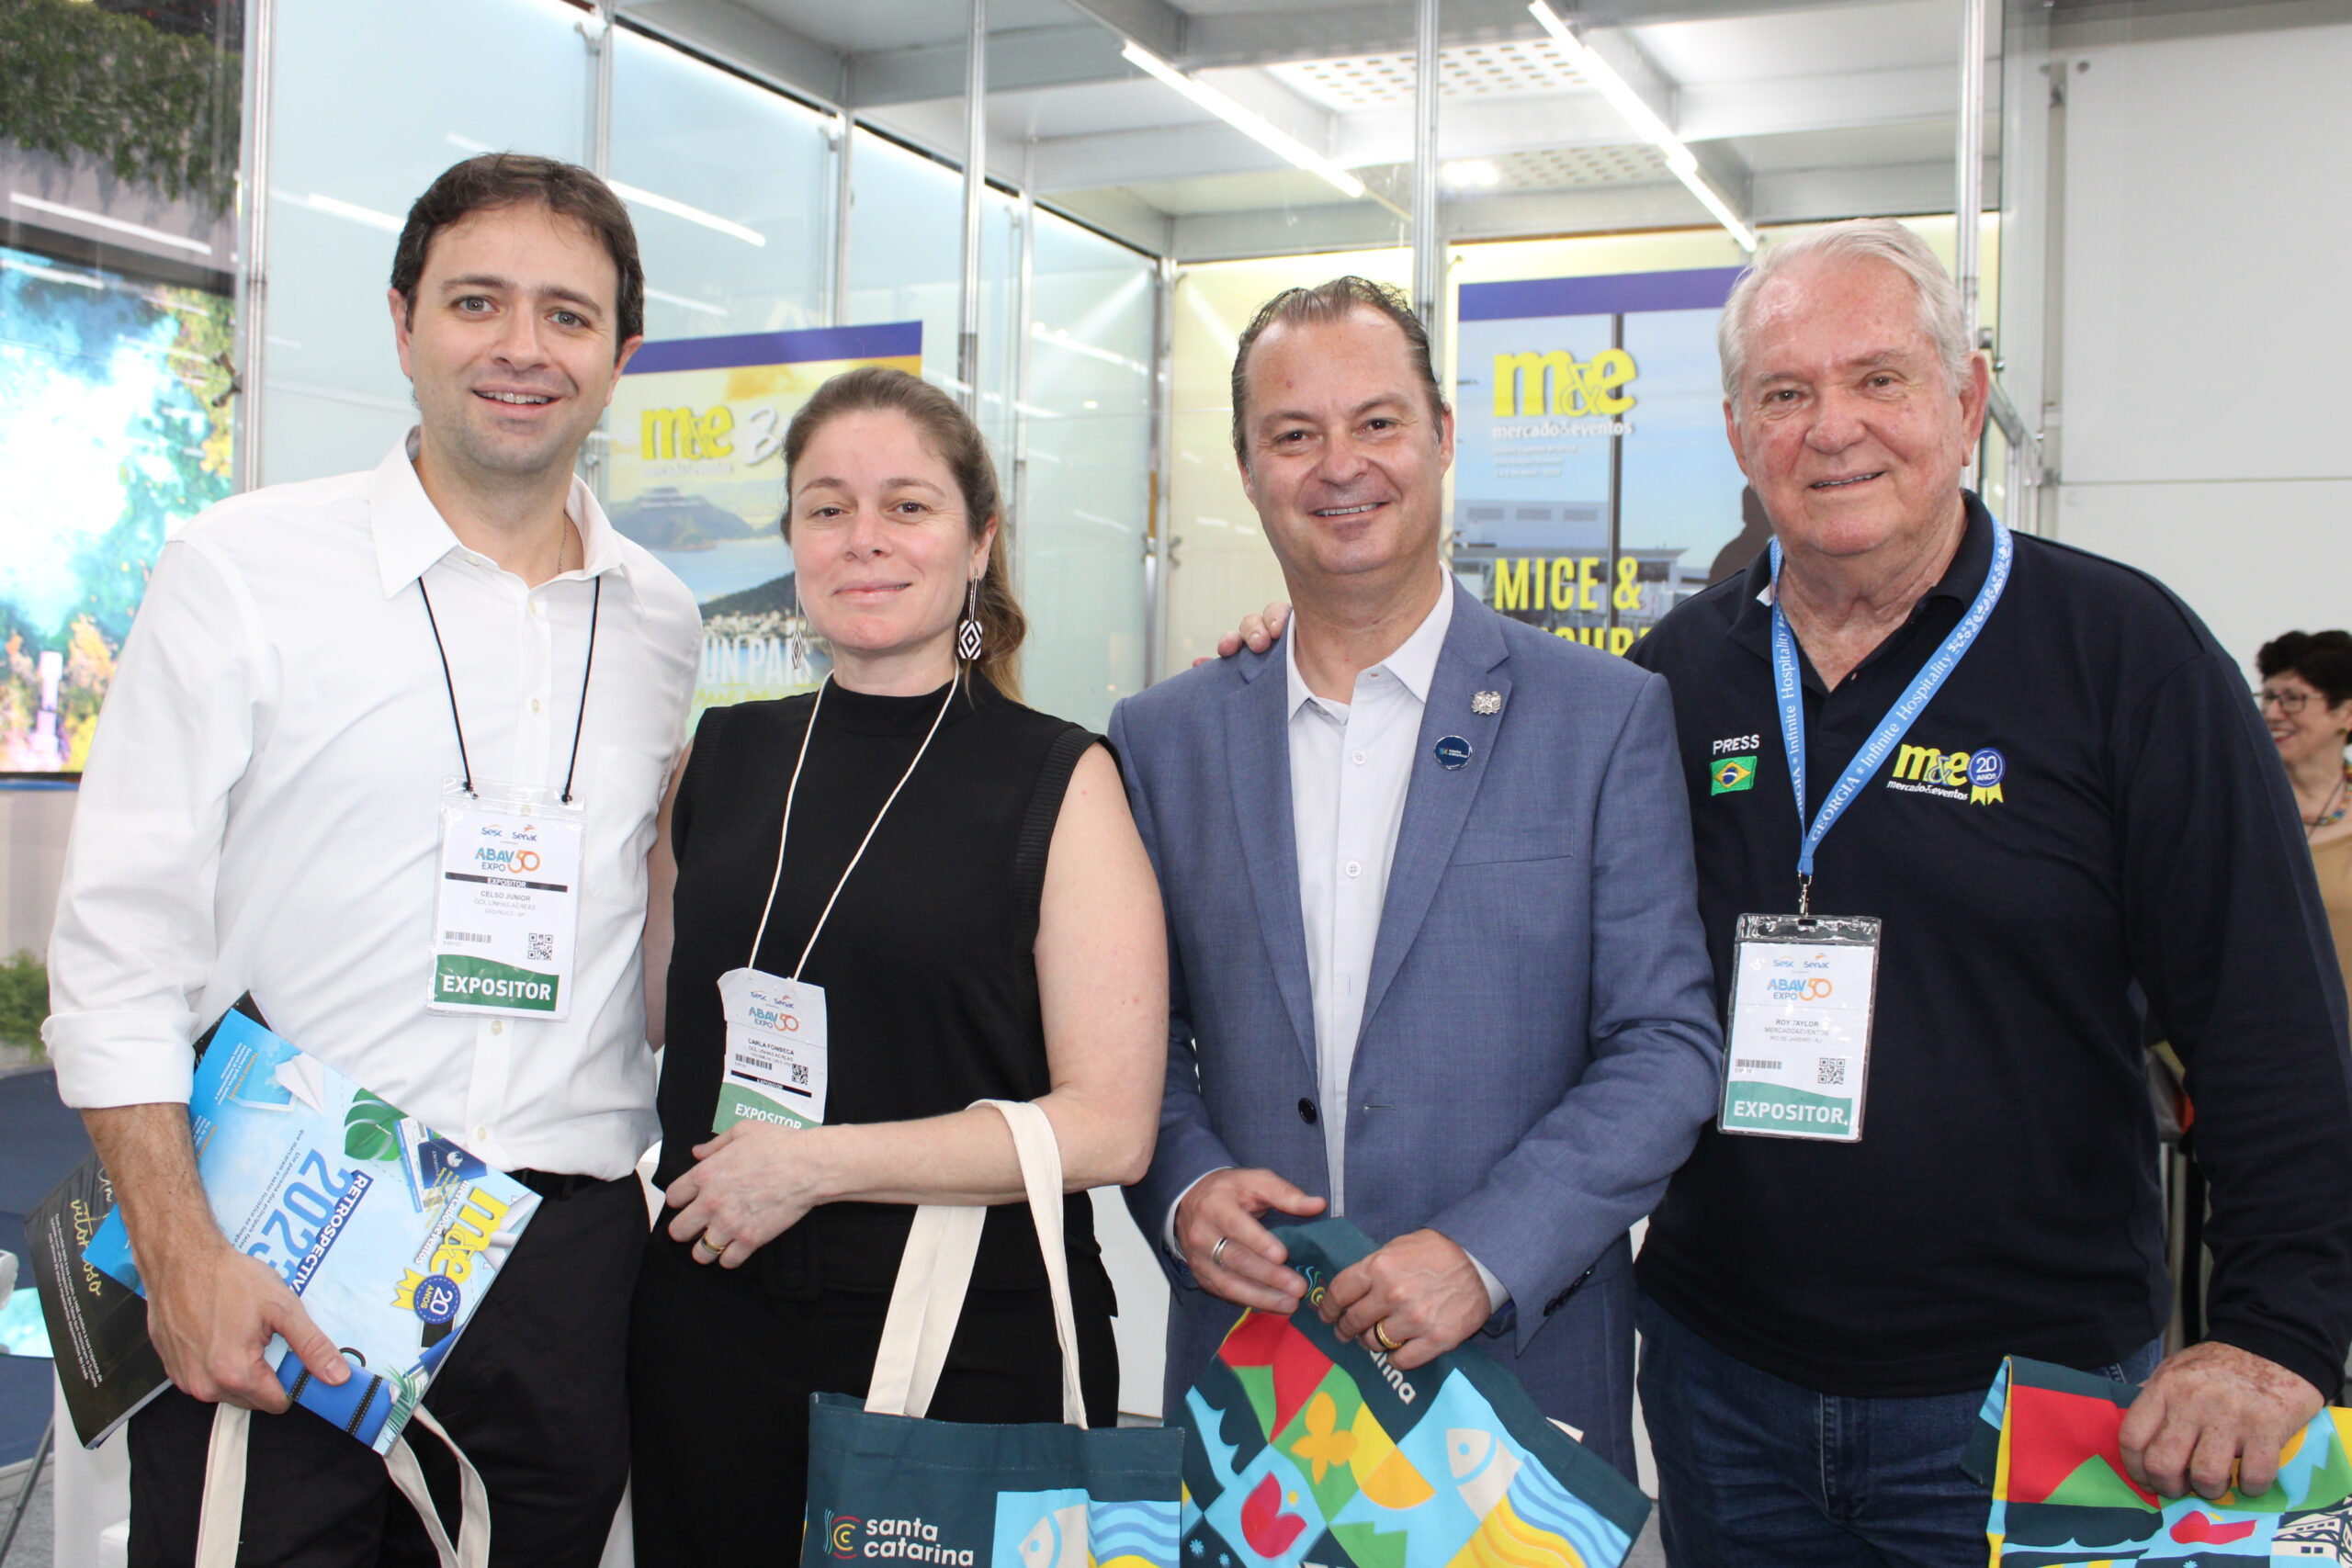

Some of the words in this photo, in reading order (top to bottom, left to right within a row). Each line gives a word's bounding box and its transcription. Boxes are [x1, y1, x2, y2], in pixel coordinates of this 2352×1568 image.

[1493, 348, 1637, 418] m&e
[641, 406, 733, 460] m&e
[1492, 420, 1634, 439] mercado&eventos
[1495, 557, 1600, 611] MICE
[1612, 556, 1643, 611] &
[1776, 630, 1795, 700] Hospitality
[1785, 705, 1800, 753] Infinite
[1713, 734, 1760, 755] PRESS
[1811, 775, 1860, 841] GEORGIA
[1860, 722, 1901, 769] Infinite
[1895, 652, 1954, 721] Hospitality
[1892, 744, 1971, 786] m&e
[1976, 755, 1997, 773] 20
[1886, 781, 1968, 800] mercado&eventos
[481, 826, 503, 837] Sesc
[512, 830, 537, 842] Senac
[474, 847, 514, 863] ABAV
[507, 850, 540, 874] 50
[481, 862, 506, 872] EXPO
[487, 877, 526, 888] EXPOSITOR
[481, 890, 503, 900] CELSO
[504, 893, 531, 902] JUNIOR
[1773, 958, 1794, 968] Sesc
[1804, 960, 1829, 969] Senac
[443, 975, 551, 1001] EXPOSITOR
[1767, 978, 1806, 991] ABAV
[1799, 977, 1833, 1001] 50
[1773, 991, 1798, 1000] EXPO
[749, 1007, 778, 1022] ABAV
[774, 998, 794, 1009] Senac
[754, 1019, 773, 1029] EXPO
[748, 1038, 766, 1048] CARLA
[767, 1043, 794, 1055] FONSECA
[288, 1173, 369, 1293] RETROSPECTIV
[415, 1179, 470, 1266] mercado&eventos
[70, 1199, 104, 1296] vitoroso
[430, 1187, 511, 1285] m&e
[419, 1284, 435, 1309] ANOS
[428, 1284, 454, 1315] 20
[865, 1517, 938, 1541] santa
[864, 1537, 974, 1567] catarina
